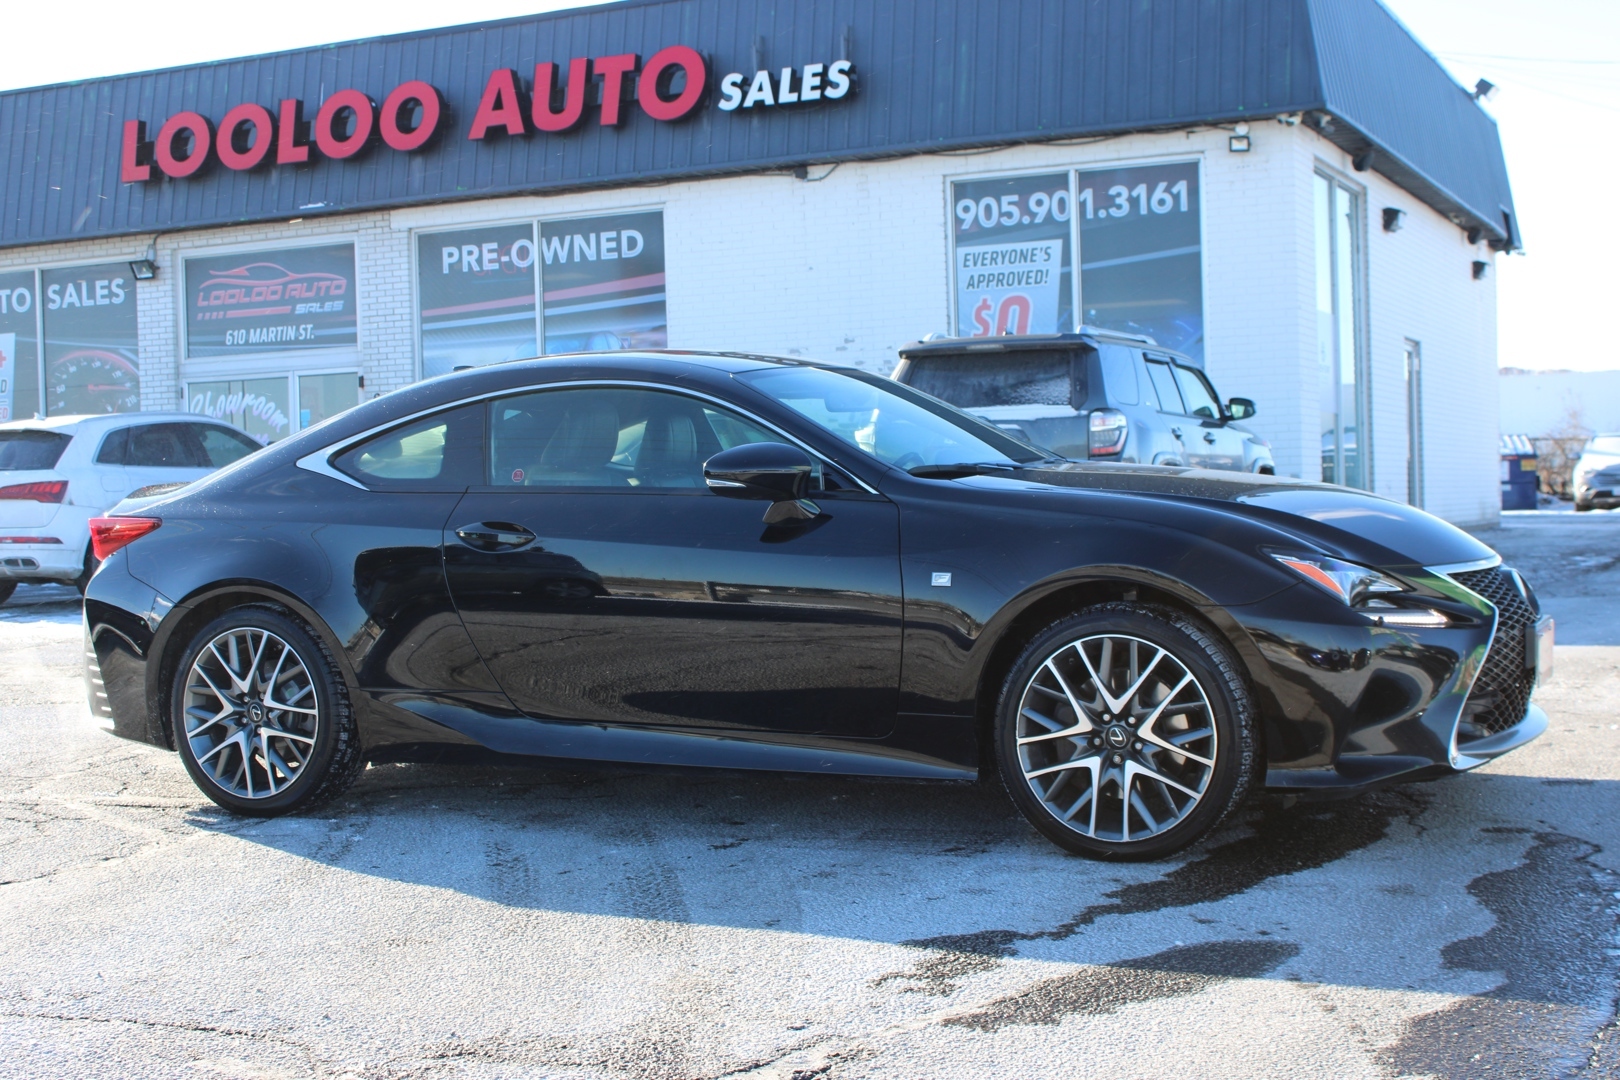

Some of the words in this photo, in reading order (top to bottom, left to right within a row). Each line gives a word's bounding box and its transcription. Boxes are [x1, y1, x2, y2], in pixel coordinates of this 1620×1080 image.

[121, 80, 441, 183] LOOLOO
[467, 44, 707, 141] AUTO
[718, 59, 852, 112] SALES
[955, 180, 1189, 230] 905.901.3161
[441, 229, 644, 275] PRE-OWNED
[962, 246, 1052, 269] EVERYONE'S
[197, 284, 283, 307] LOOLOO
[285, 279, 347, 300] AUTO
[965, 268, 1050, 291] APPROVED!
[47, 278, 125, 310] SALES
[295, 300, 344, 315] SALES
[225, 329, 246, 346] 610
[249, 325, 296, 344] MARTIN
[299, 324, 315, 340] ST.
